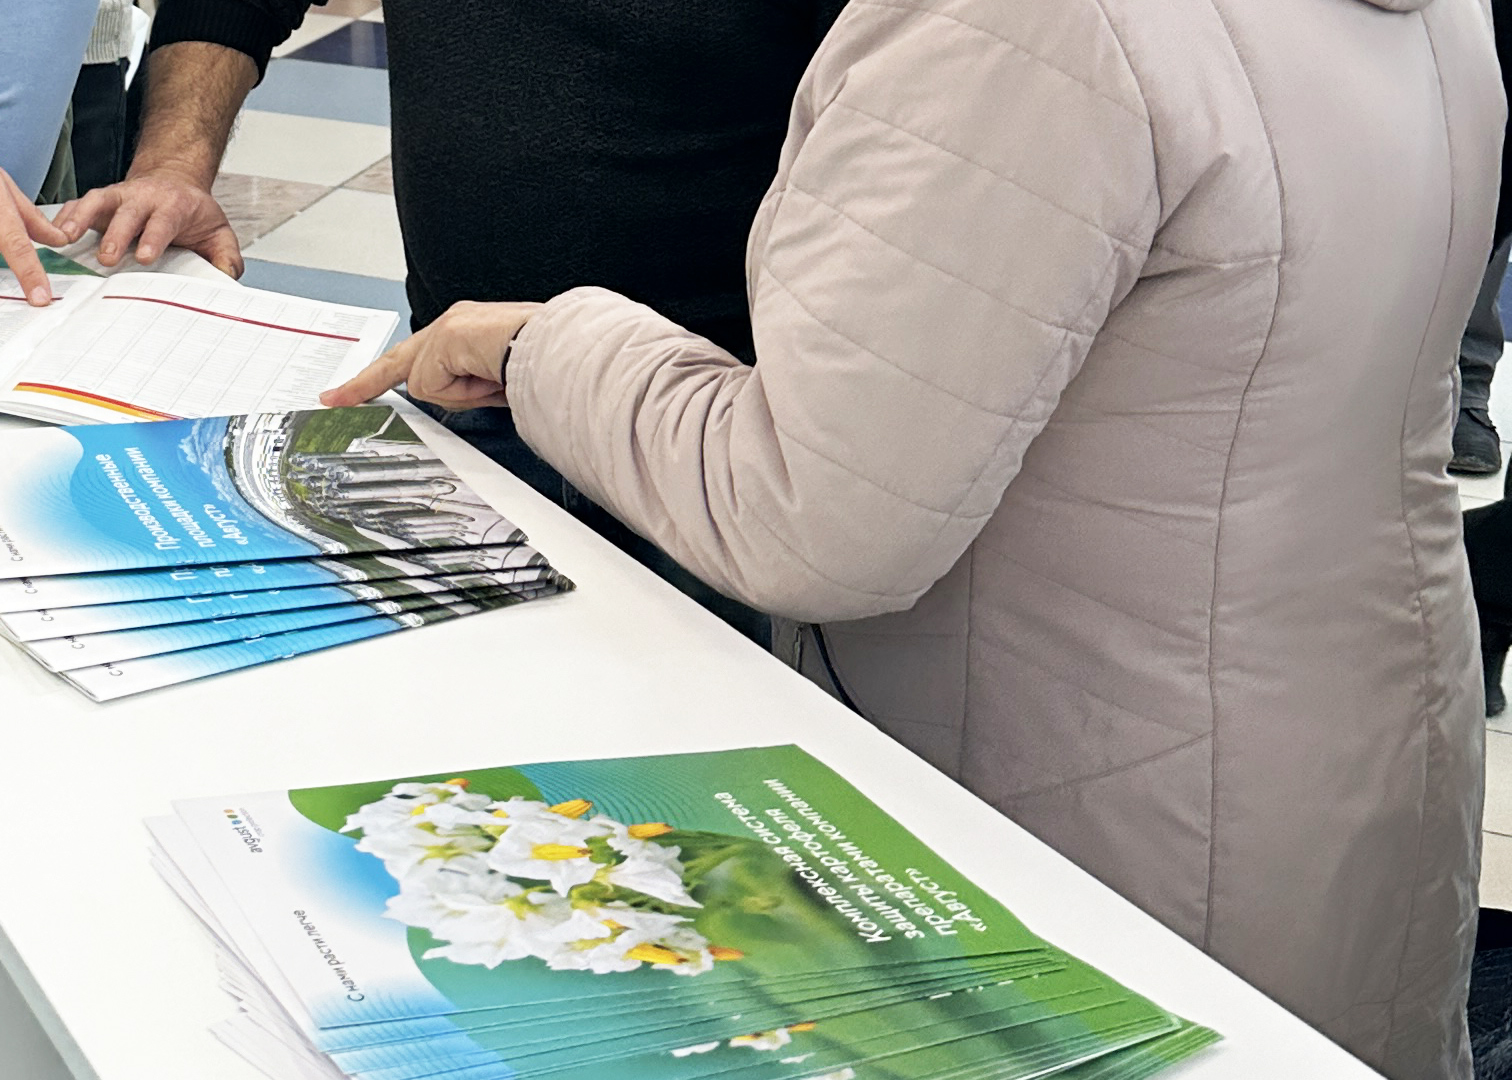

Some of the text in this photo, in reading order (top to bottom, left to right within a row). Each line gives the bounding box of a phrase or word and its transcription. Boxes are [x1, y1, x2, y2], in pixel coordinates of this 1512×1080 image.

[95, 453, 181, 550] Производственные
[124, 447, 174, 500] компании
[161, 499, 216, 548] площадки
[203, 503, 249, 546] «Август»
[232, 826, 263, 853] avgust
[714, 792, 892, 943] Комплексная система
[762, 778, 958, 935] препаратами компании
[765, 808, 925, 939] защиты картофеля
[905, 867, 987, 932] «Август»
[293, 910, 365, 1002] С нами расти легче
